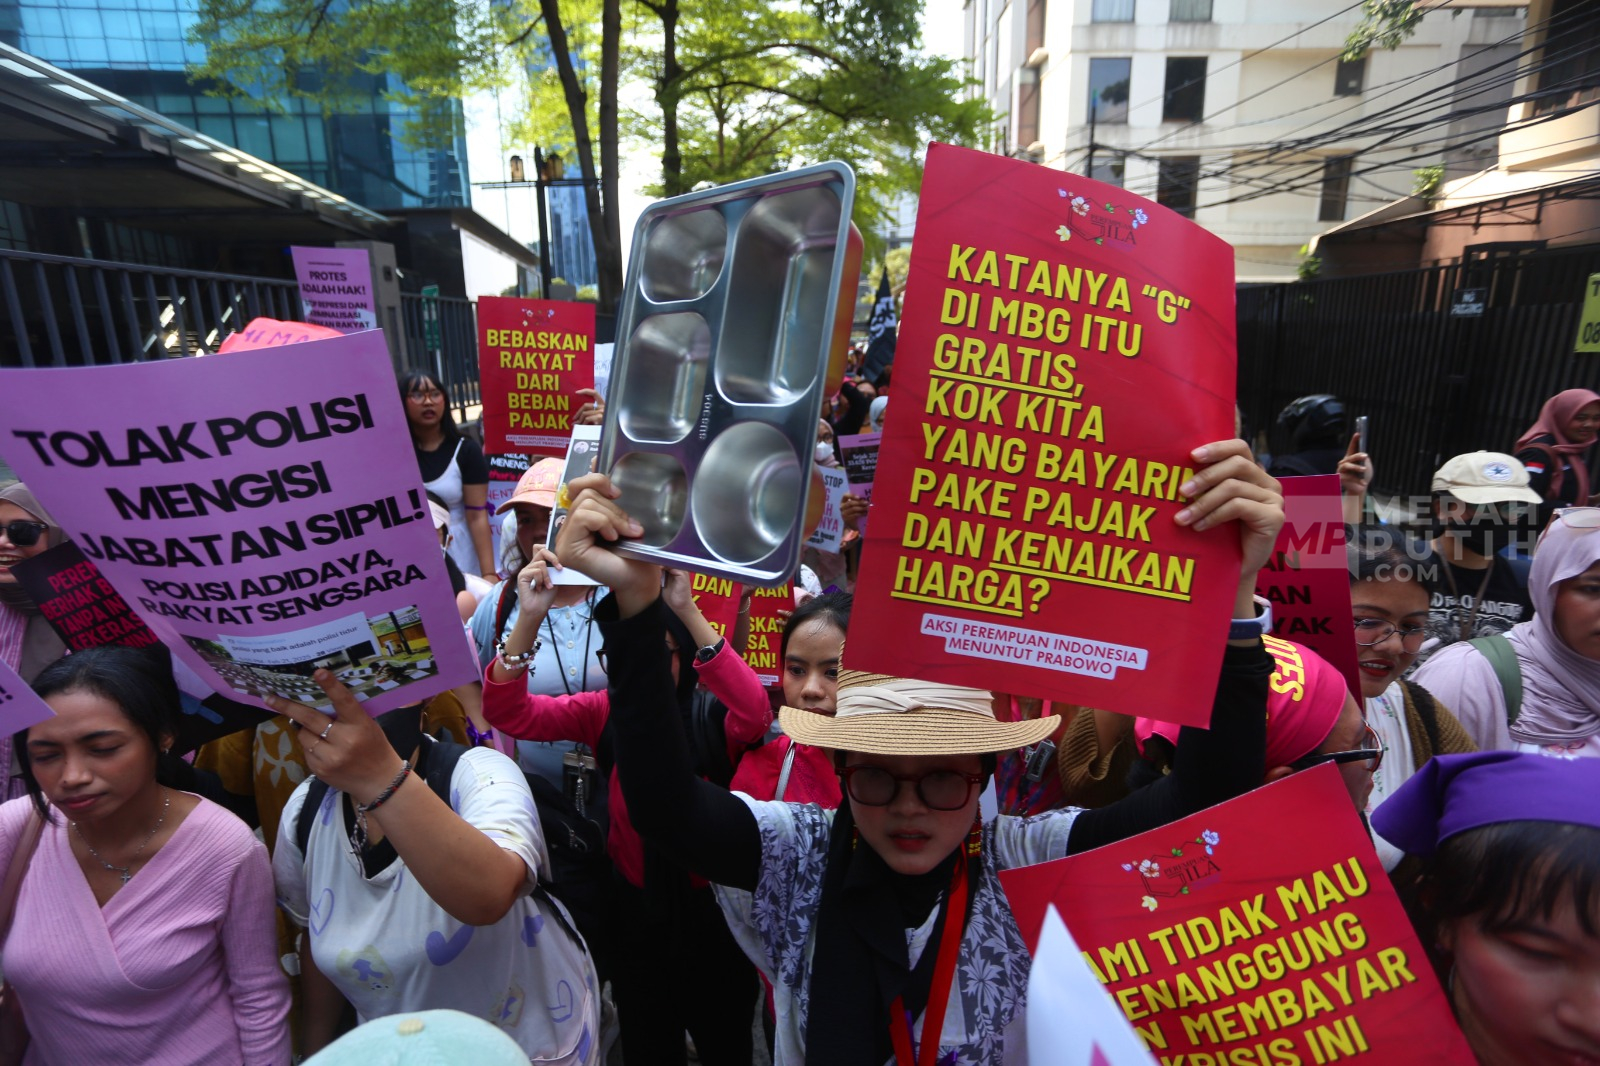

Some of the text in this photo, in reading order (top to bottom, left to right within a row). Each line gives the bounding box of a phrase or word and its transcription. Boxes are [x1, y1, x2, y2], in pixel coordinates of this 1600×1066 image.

[302, 283, 366, 295] ADALAH HAK!
[309, 270, 347, 282] PROTES
[948, 244, 1132, 313] KATANYA
[486, 329, 588, 352] BEBASKAN
[941, 287, 981, 328] DI
[989, 297, 1072, 344] MBG
[1080, 313, 1142, 357] ITU
[500, 351, 575, 371] RAKYAT
[517, 373, 560, 391] DARI
[931, 333, 1084, 398] GRATIS,
[508, 392, 569, 411] BEBAN
[509, 412, 570, 430] PAJAK
[925, 377, 1105, 443] KOK KITA
[12, 393, 375, 468] TOLAK POLISI
[922, 422, 1027, 475] YANG
[105, 460, 332, 521] MENGISI
[824, 474, 844, 488] STOP
[909, 467, 1156, 542] PAKE PAJAK
[79, 488, 426, 568] JABATAN SIPIL!
[902, 512, 1195, 597] DAN KENAIKAN
[38, 583, 100, 621] BERHAK
[137, 563, 427, 626] RAKYAT SENGSARA
[140, 548, 393, 603] POLISI ADIDAYA,
[692, 572, 733, 598] DAN
[891, 556, 1050, 617] HARGA?
[55, 604, 110, 635] TANPA
[289, 639, 317, 650] adalah
[317, 632, 339, 644] polisi
[339, 626, 358, 636] tidur
[924, 618, 1139, 665] AKSI PEREMPUAN INDONESIA
[948, 638, 1112, 674] MENUNTUT PRABOWO
[1148, 894, 1279, 966] TIDAK
[1276, 857, 1369, 922] MAU
[1108, 912, 1367, 1022] ENANGGUNG
[1180, 946, 1417, 1047] MEMBAYAR
[1304, 1015, 1370, 1065] INI
